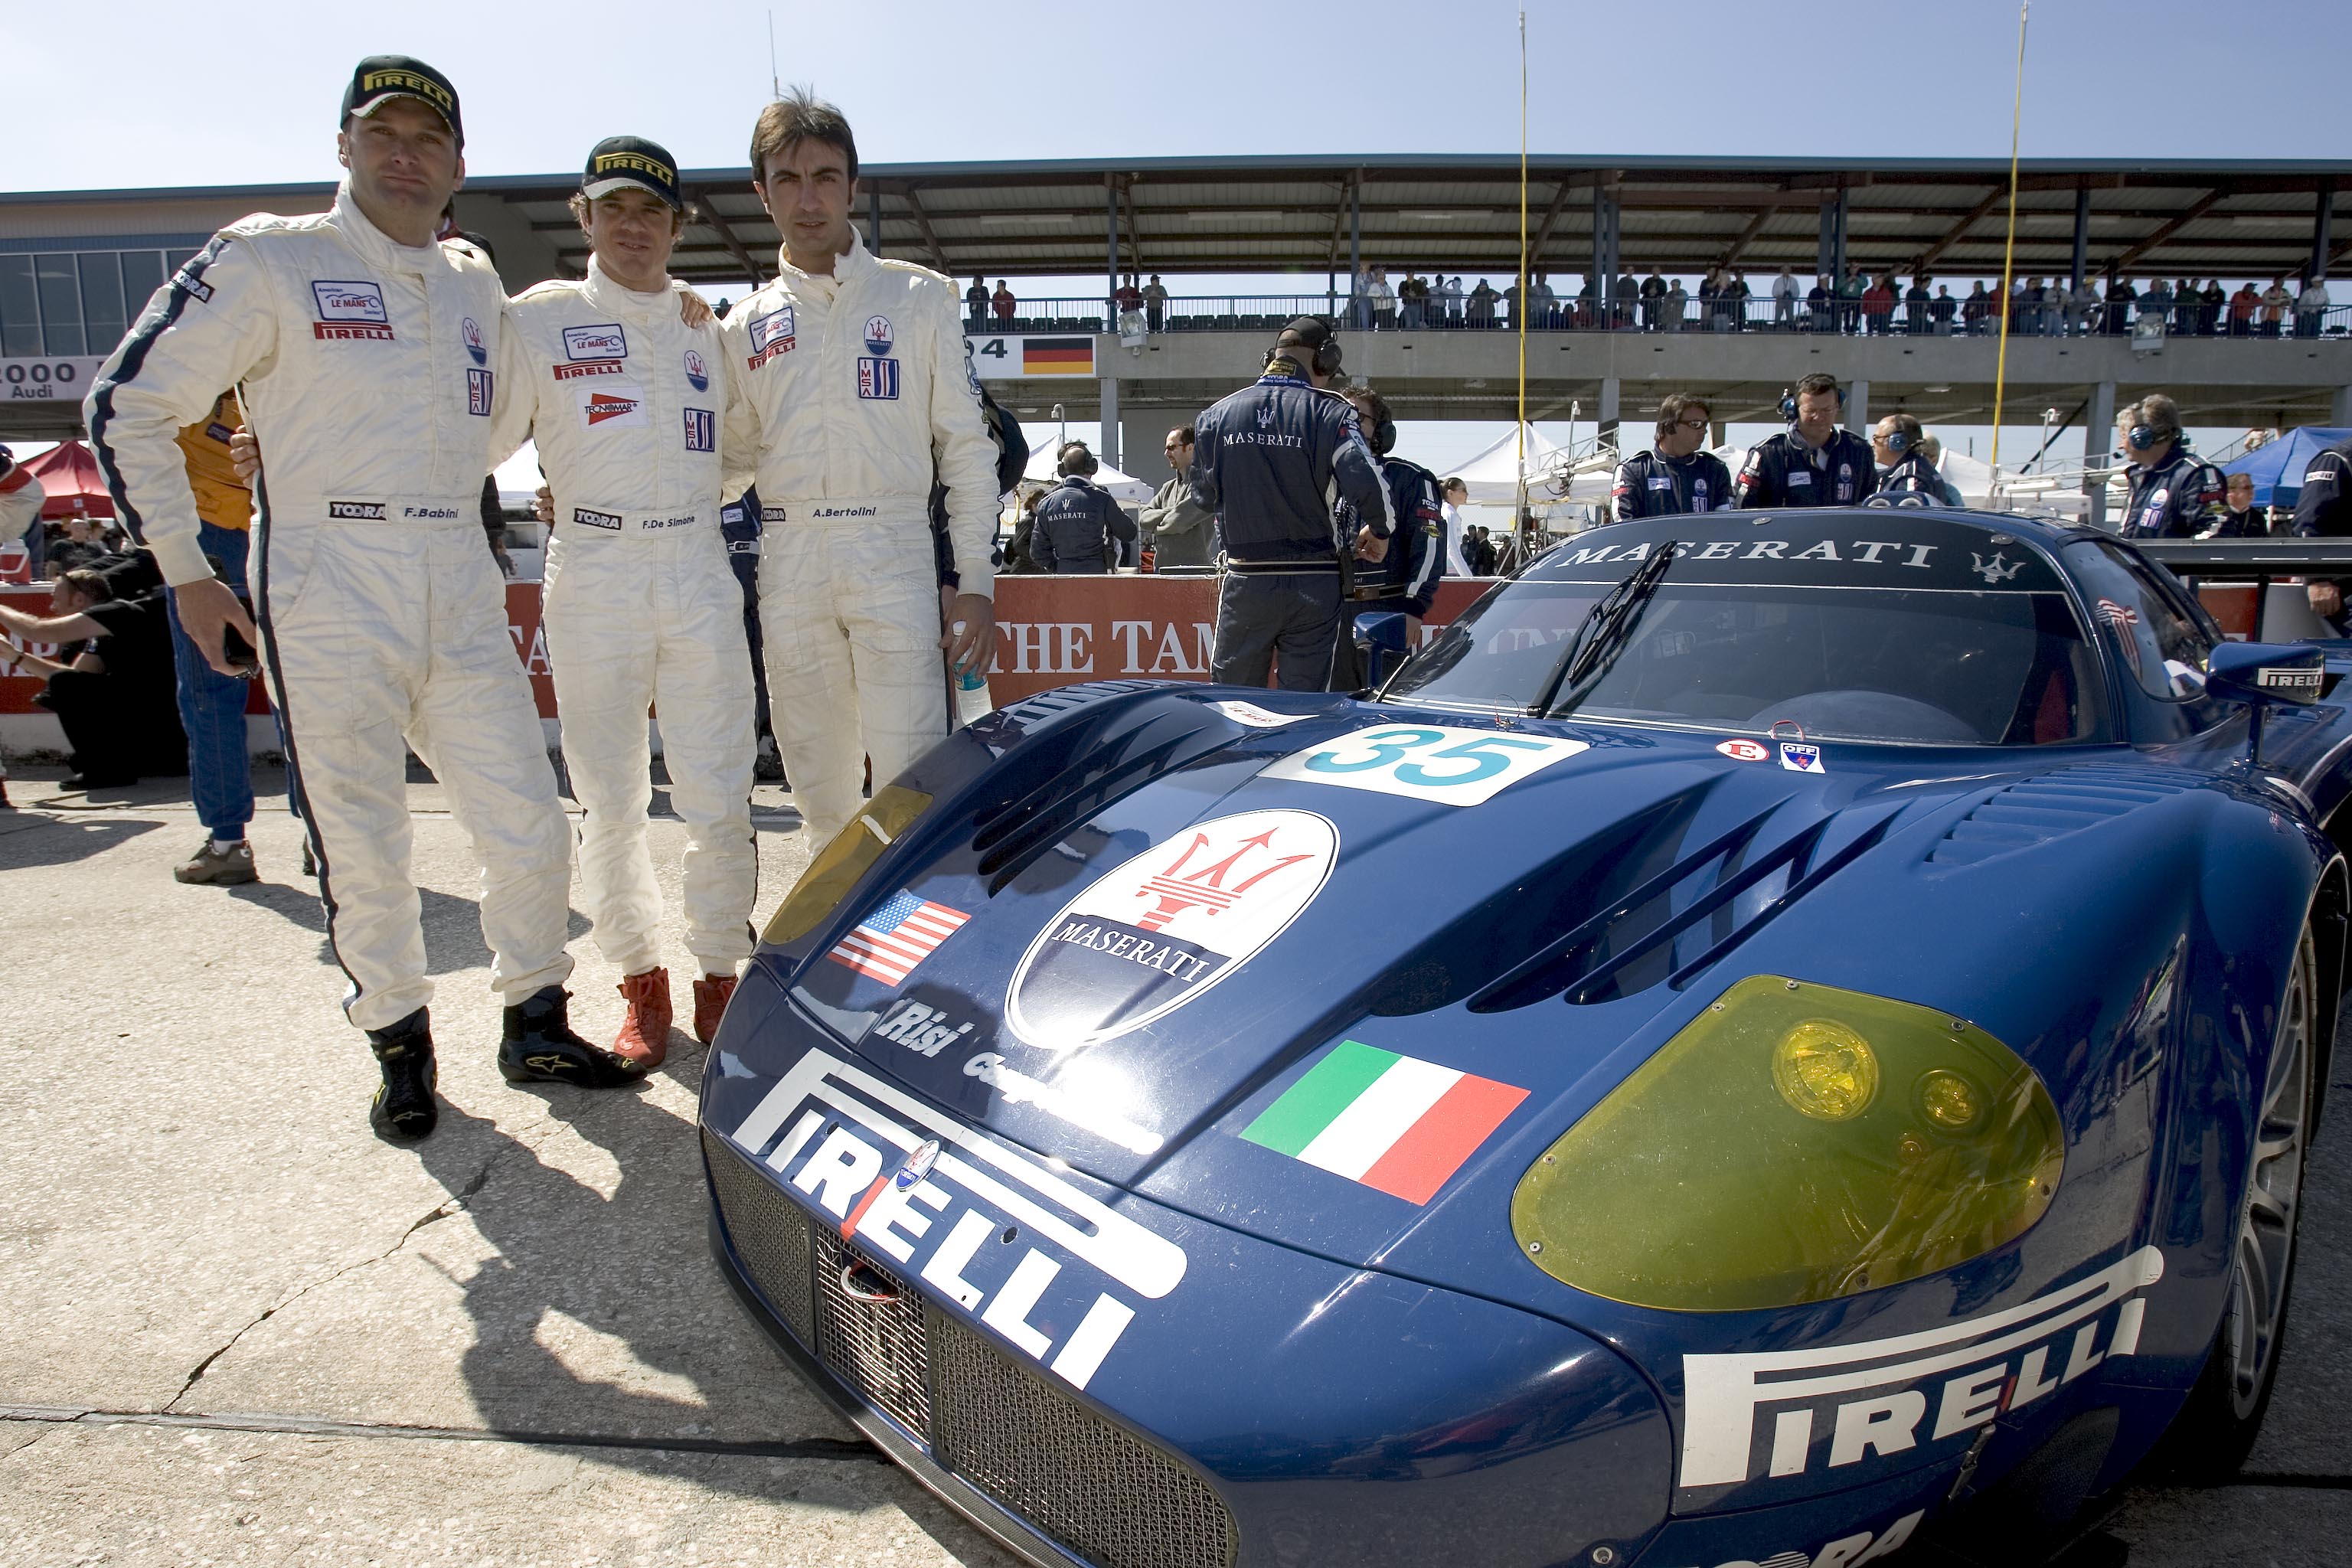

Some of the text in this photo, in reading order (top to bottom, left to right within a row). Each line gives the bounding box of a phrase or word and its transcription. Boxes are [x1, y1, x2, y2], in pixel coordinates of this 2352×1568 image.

[364, 69, 453, 111] PIRELLI
[596, 152, 674, 187] PIRELLI
[331, 299, 367, 308] LE MANS
[313, 322, 395, 341] PIRELLI
[588, 339, 609, 348] MANS
[747, 336, 796, 371] PIRELLI
[0, 363, 76, 384] 000
[553, 360, 623, 381] PIRELLI
[861, 360, 871, 397] IMSA
[11, 384, 54, 398] Audi
[470, 371, 481, 413] IMSA
[584, 403, 634, 414] TECNOMAR
[687, 411, 696, 449] IMSA
[1223, 432, 1303, 448] MASERATI
[404, 507, 459, 519] F.Babini
[642, 514, 695, 530] F.De Simone
[812, 507, 877, 518] A.Bertolini
[1047, 511, 1086, 521] MASERATI
[1555, 540, 1939, 568] MASERATI
[988, 621, 1094, 674] THE
[1304, 730, 1554, 786] 35
[1727, 743, 1756, 759] E
[1783, 745, 1817, 755] OFF
[1052, 921, 1210, 982] MASERATI
[874, 1001, 975, 1058] Risi
[730, 1047, 1188, 1392] PIRELLI
[1679, 1244, 2164, 1480] PIRELLI
